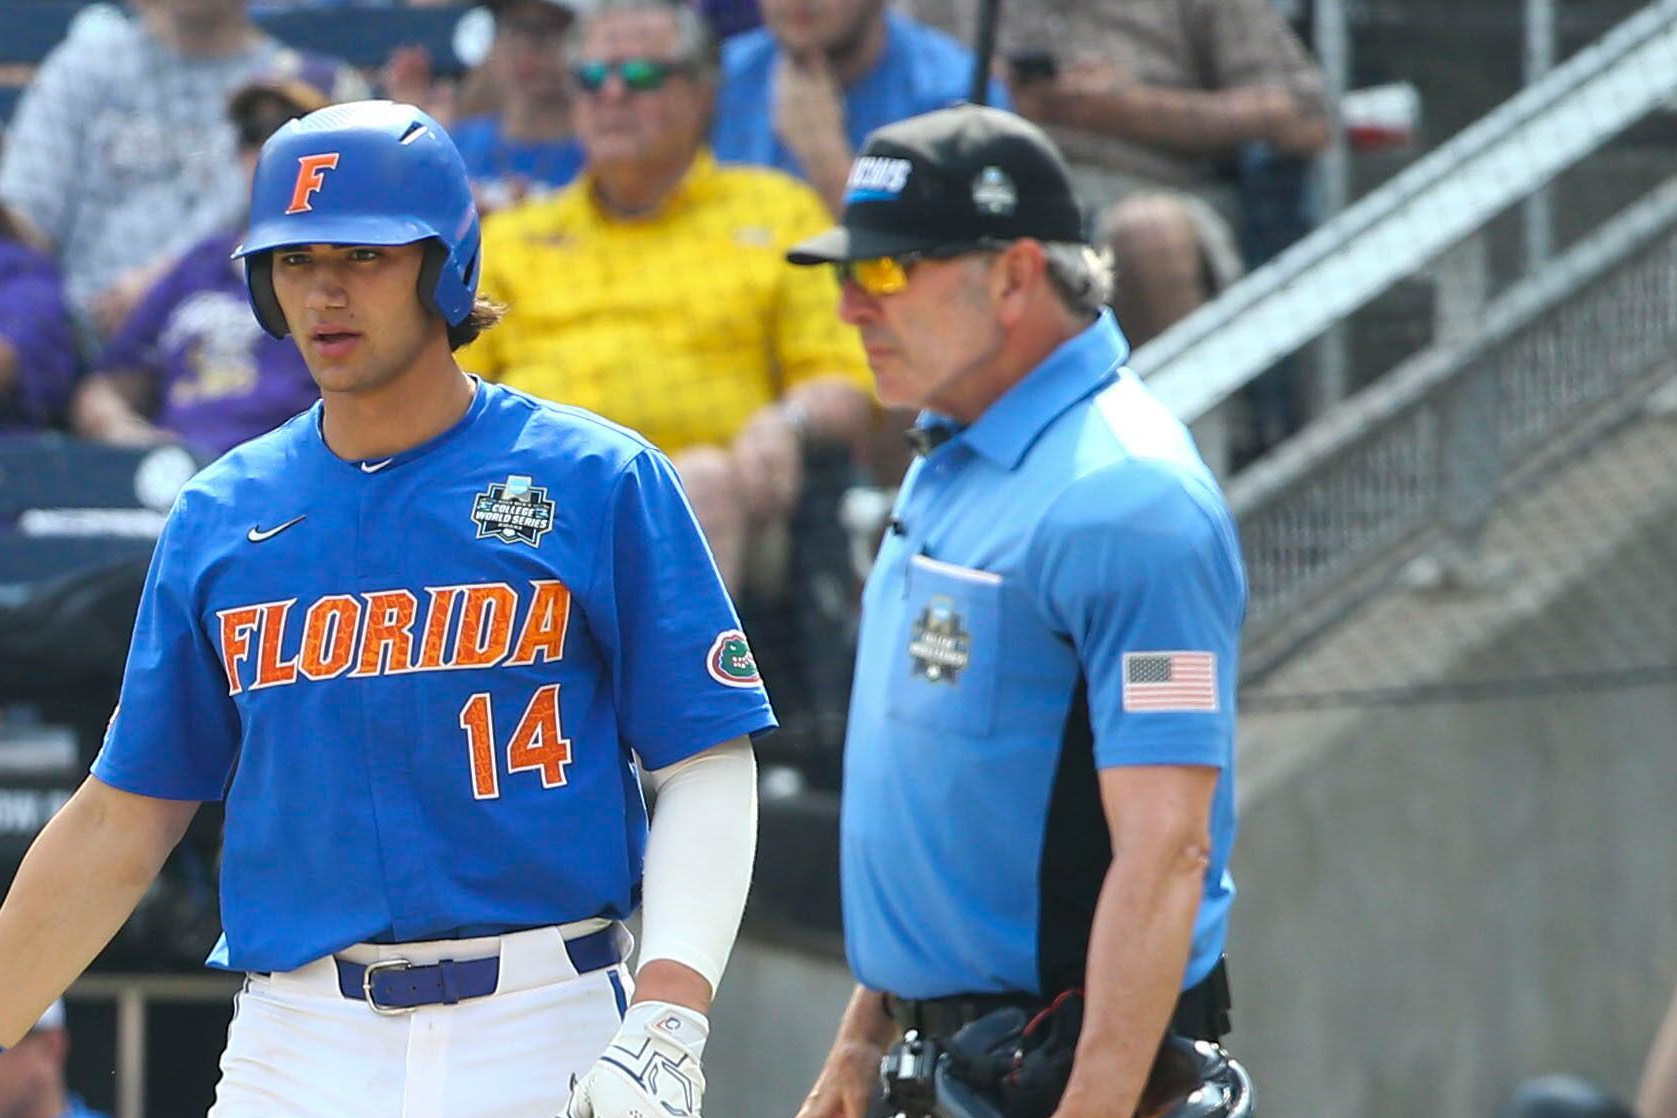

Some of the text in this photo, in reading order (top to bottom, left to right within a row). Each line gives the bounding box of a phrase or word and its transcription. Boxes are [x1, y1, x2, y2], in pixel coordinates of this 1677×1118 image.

[285, 152, 340, 215] F
[475, 510, 512, 524] WORLD
[511, 514, 548, 529] SERIES
[491, 503, 535, 518] COLLEGE
[216, 580, 570, 696] FLORIDA
[459, 683, 572, 800] 14
